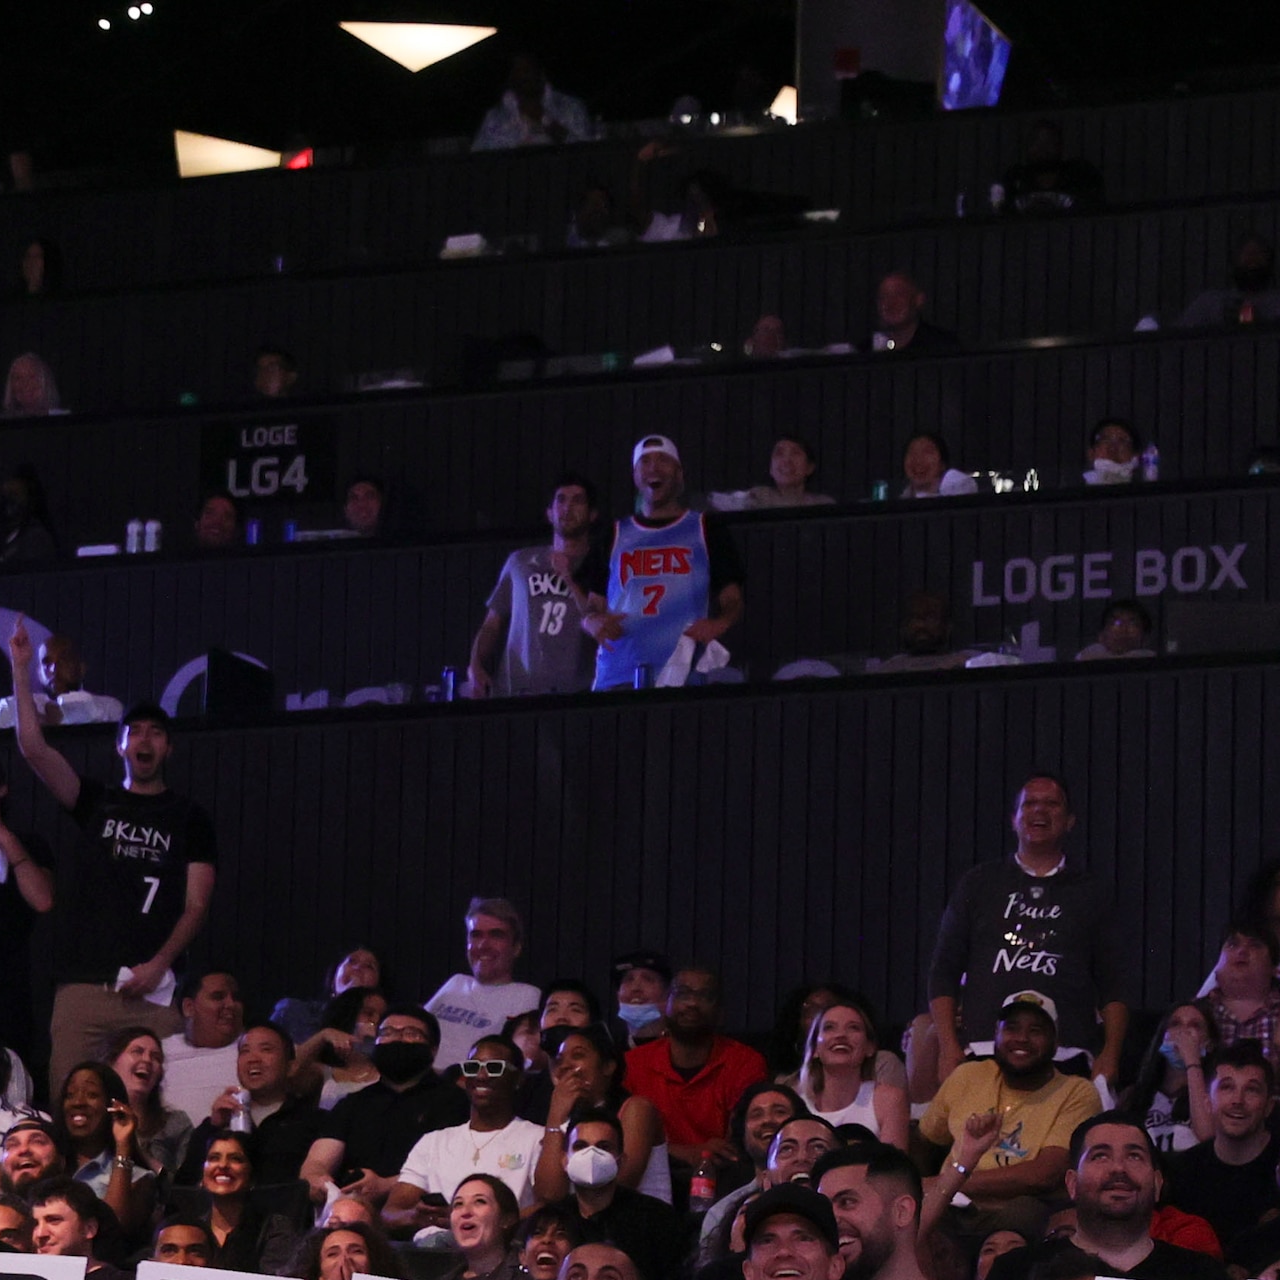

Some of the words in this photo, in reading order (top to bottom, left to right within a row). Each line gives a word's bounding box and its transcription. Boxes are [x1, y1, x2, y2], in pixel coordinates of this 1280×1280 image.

[241, 424, 299, 448] LOGE
[227, 454, 309, 498] LG4
[620, 547, 692, 586] NETS
[971, 551, 1114, 606] LOGE
[1134, 543, 1250, 596] BOX
[643, 584, 666, 617] 7
[540, 600, 568, 636] 13
[101, 819, 171, 852] BKLYN
[141, 876, 161, 915] 7
[1002, 891, 1063, 920] Peace
[992, 946, 1065, 977] Nets
